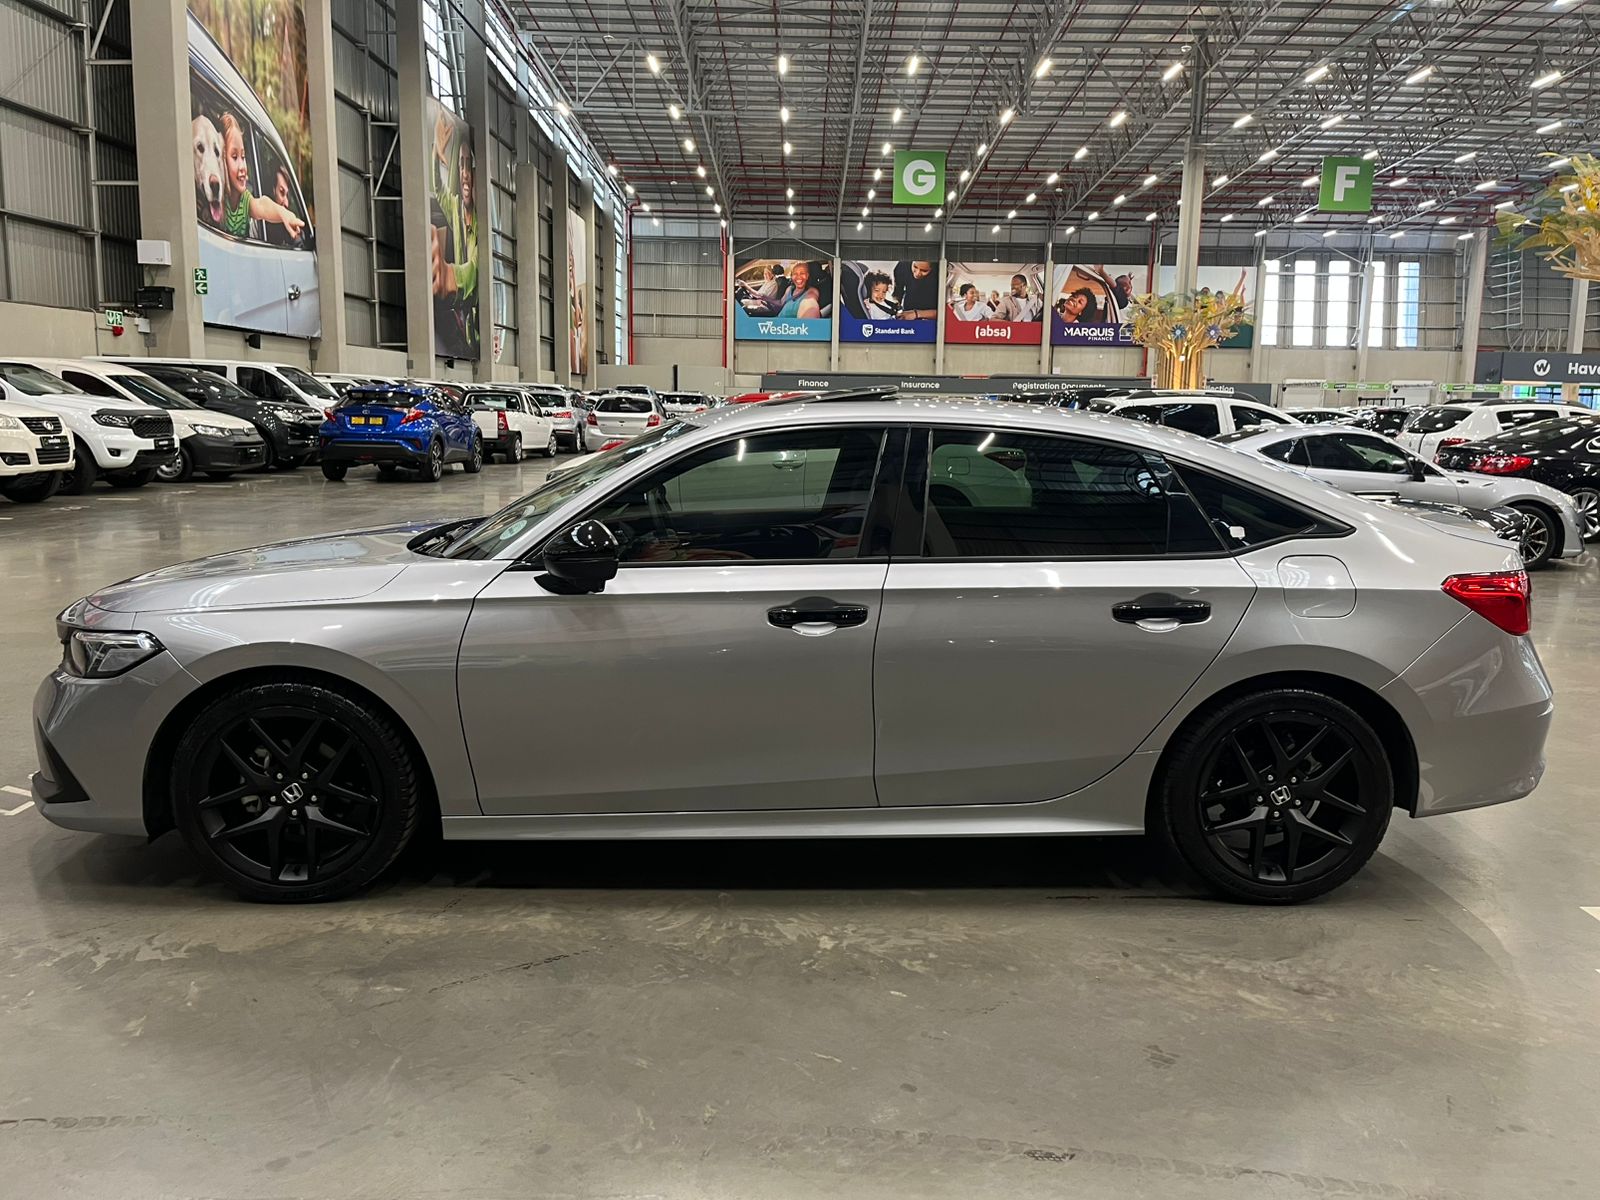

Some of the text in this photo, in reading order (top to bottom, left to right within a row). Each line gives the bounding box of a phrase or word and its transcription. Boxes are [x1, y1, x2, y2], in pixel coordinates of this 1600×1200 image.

[902, 159, 936, 196] G
[1333, 166, 1360, 201] F
[758, 321, 809, 336] WesBank
[875, 327, 900, 335] Standard
[1064, 327, 1115, 337] MARQUIS
[798, 379, 829, 387] Finance
[901, 381, 941, 389] Insurance
[1012, 382, 1060, 391] Registration
